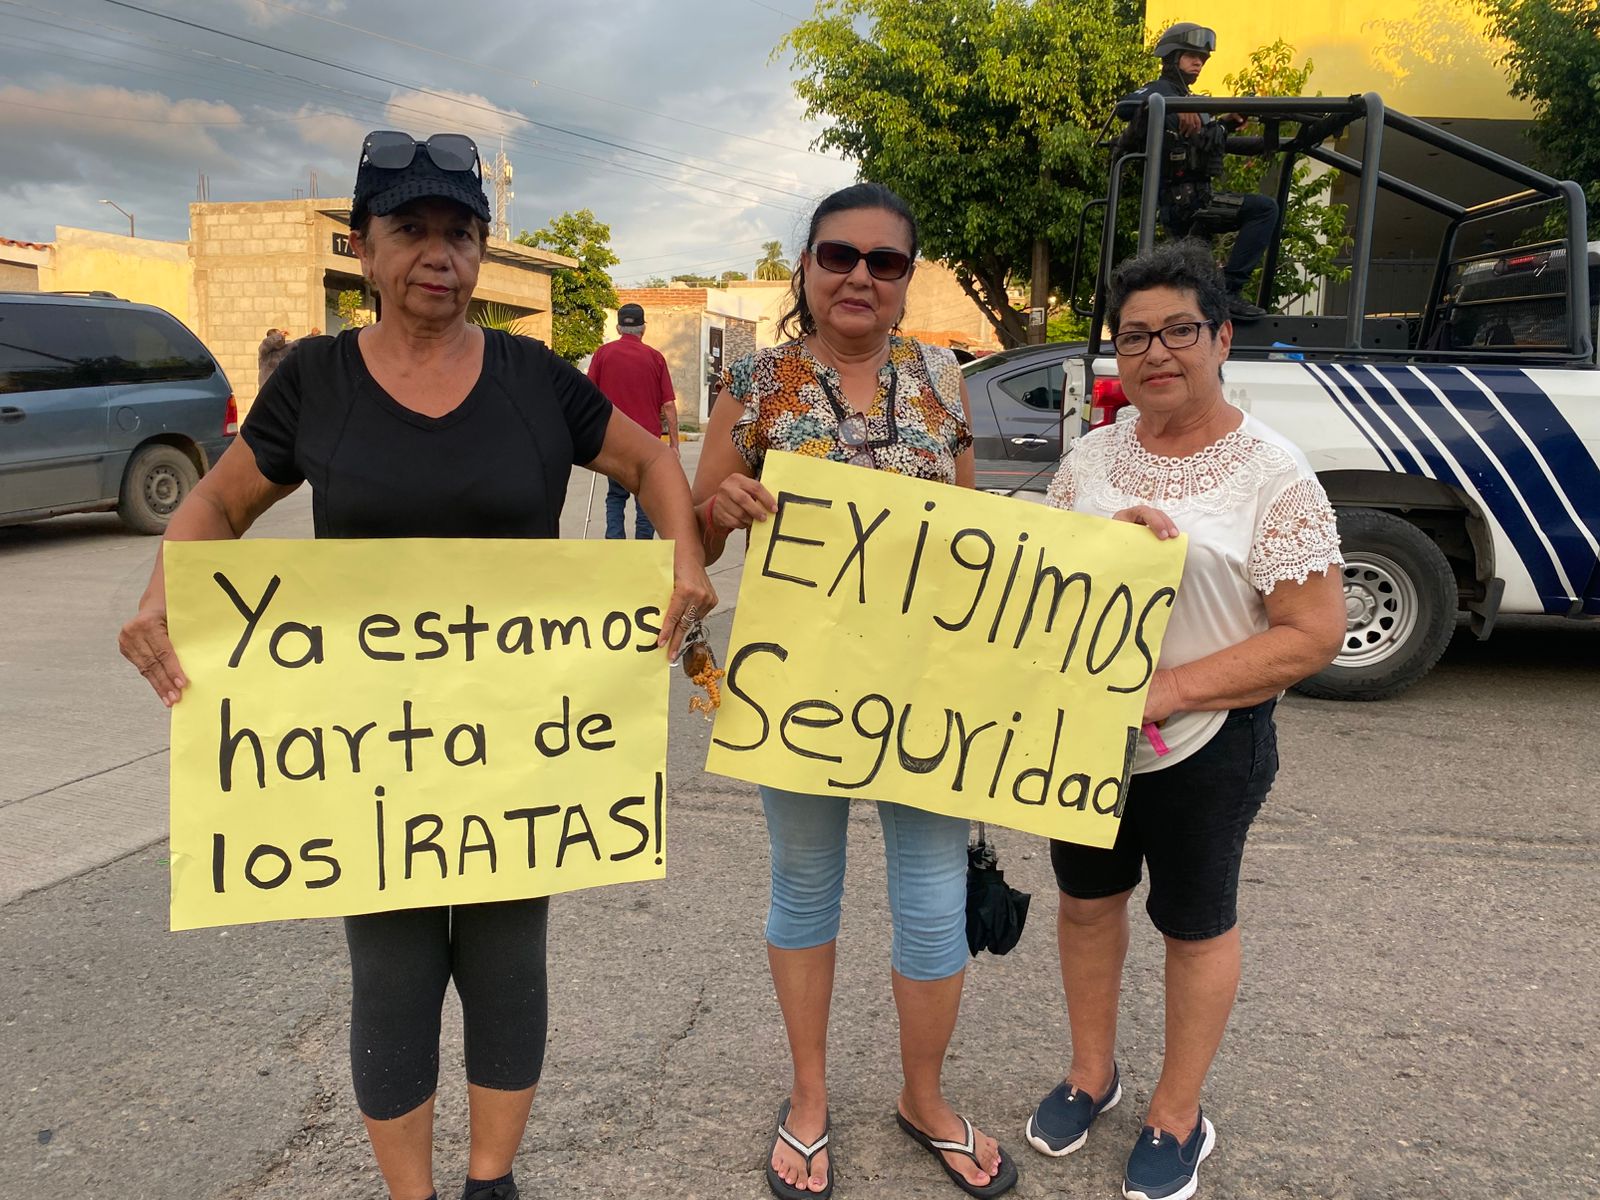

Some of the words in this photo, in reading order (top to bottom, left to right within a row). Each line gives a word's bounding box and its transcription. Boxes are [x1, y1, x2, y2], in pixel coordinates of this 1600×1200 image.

[336, 237, 356, 255] 17
[213, 571, 324, 668] Ya
[358, 604, 665, 662] estamos
[219, 697, 487, 792] harta
[534, 695, 617, 758] de
[712, 641, 1140, 819] Seguridad
[212, 832, 342, 893] los
[374, 771, 665, 891] ¡RATAS!
